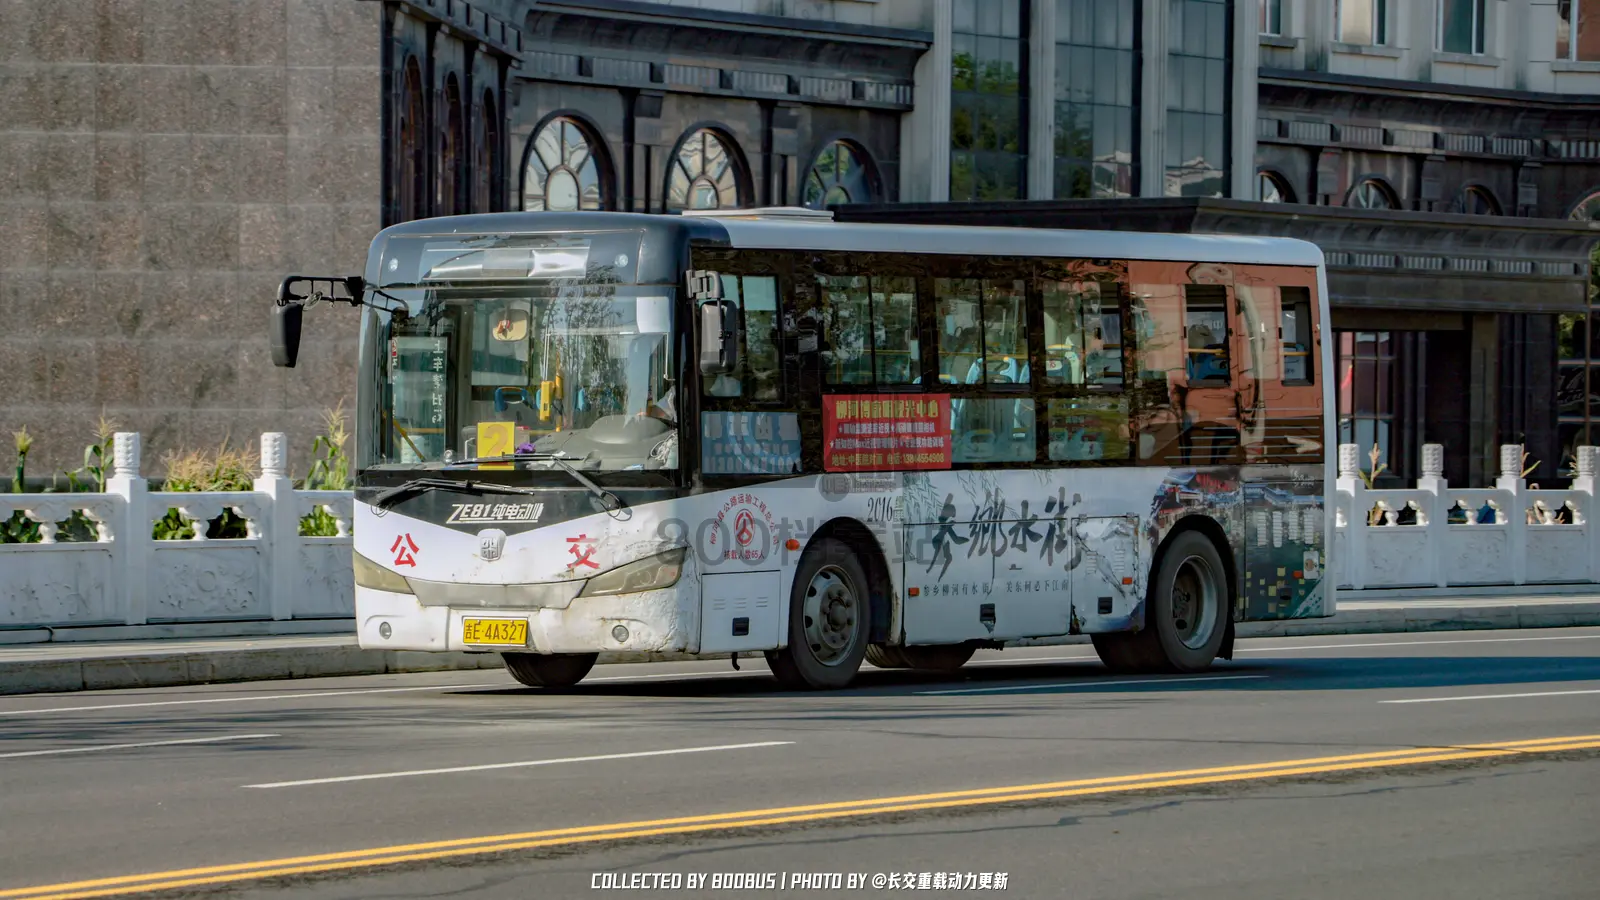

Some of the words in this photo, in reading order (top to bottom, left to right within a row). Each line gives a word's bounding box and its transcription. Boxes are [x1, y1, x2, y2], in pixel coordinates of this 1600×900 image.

[483, 424, 508, 457] 2
[390, 533, 420, 568] 公
[566, 533, 600, 569] 交
